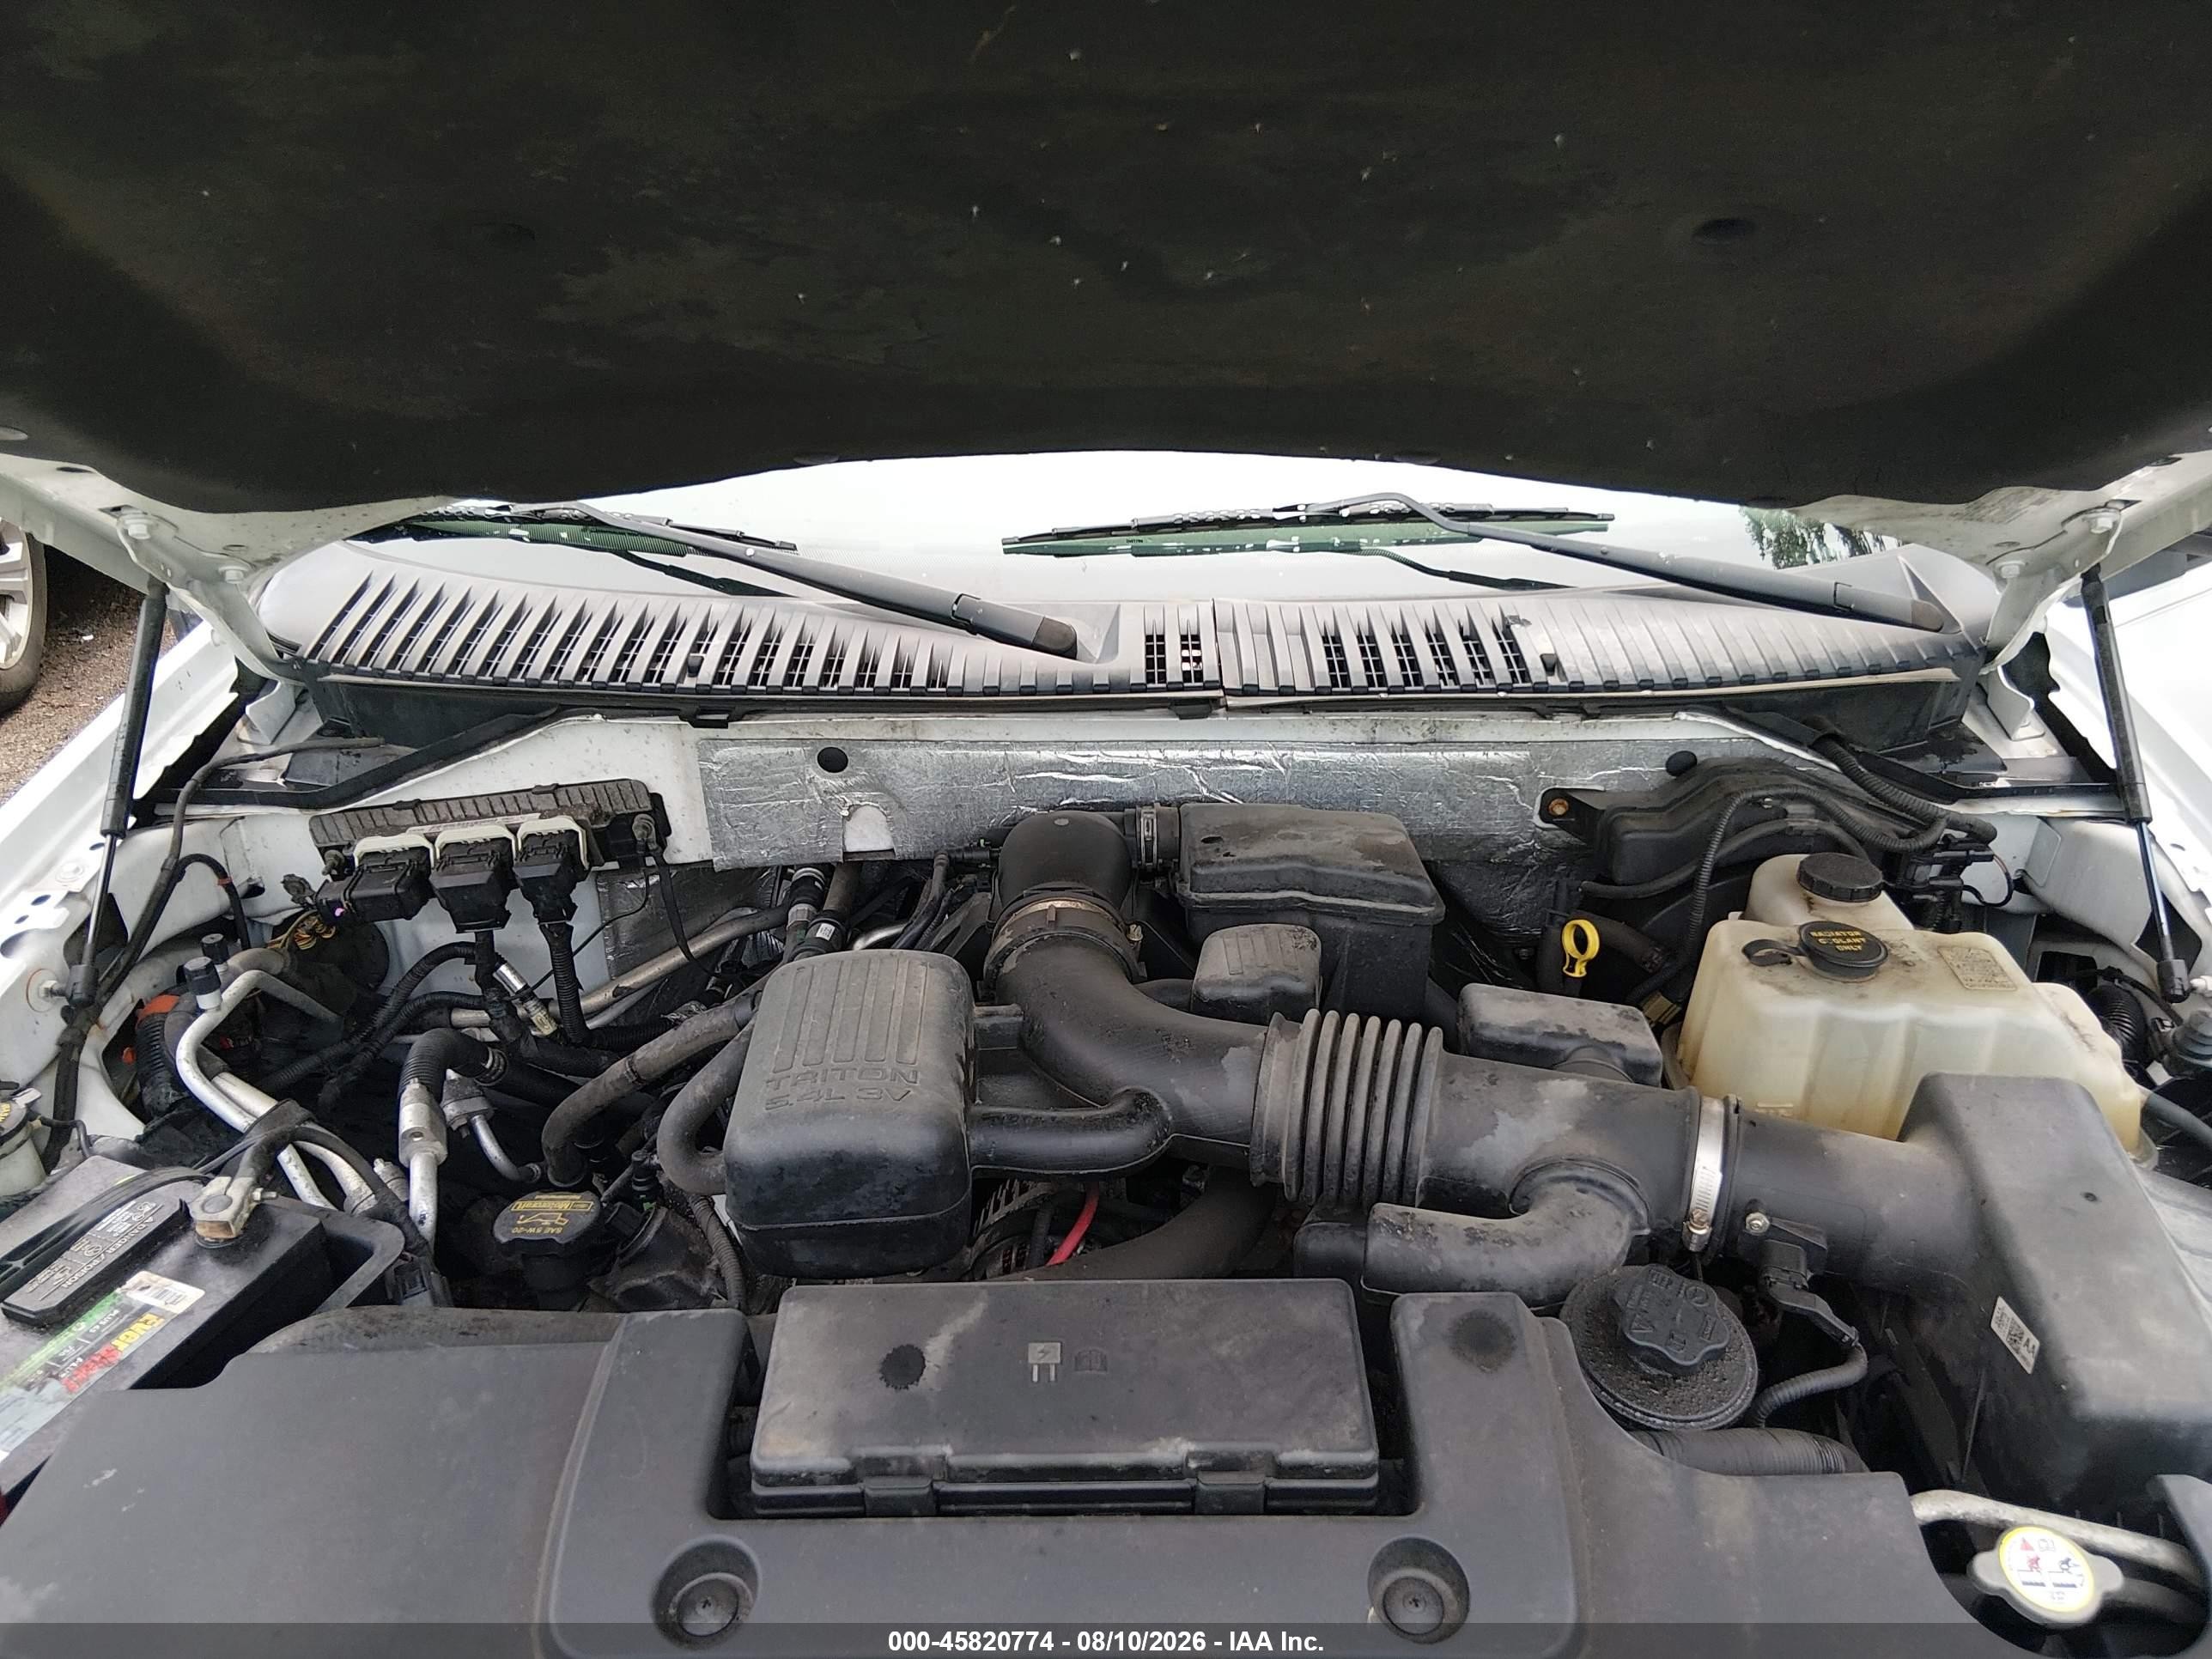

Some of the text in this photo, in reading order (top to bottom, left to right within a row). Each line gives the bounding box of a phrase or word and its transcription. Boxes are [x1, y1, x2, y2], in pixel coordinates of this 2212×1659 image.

[766, 1068, 919, 1091] TRITON
[765, 1087, 911, 1110] 5.4L 3V
[106, 1223, 149, 1255] DANGER
[99, 1309, 120, 1328] PLUS
[61, 1312, 166, 1394] EverStart
